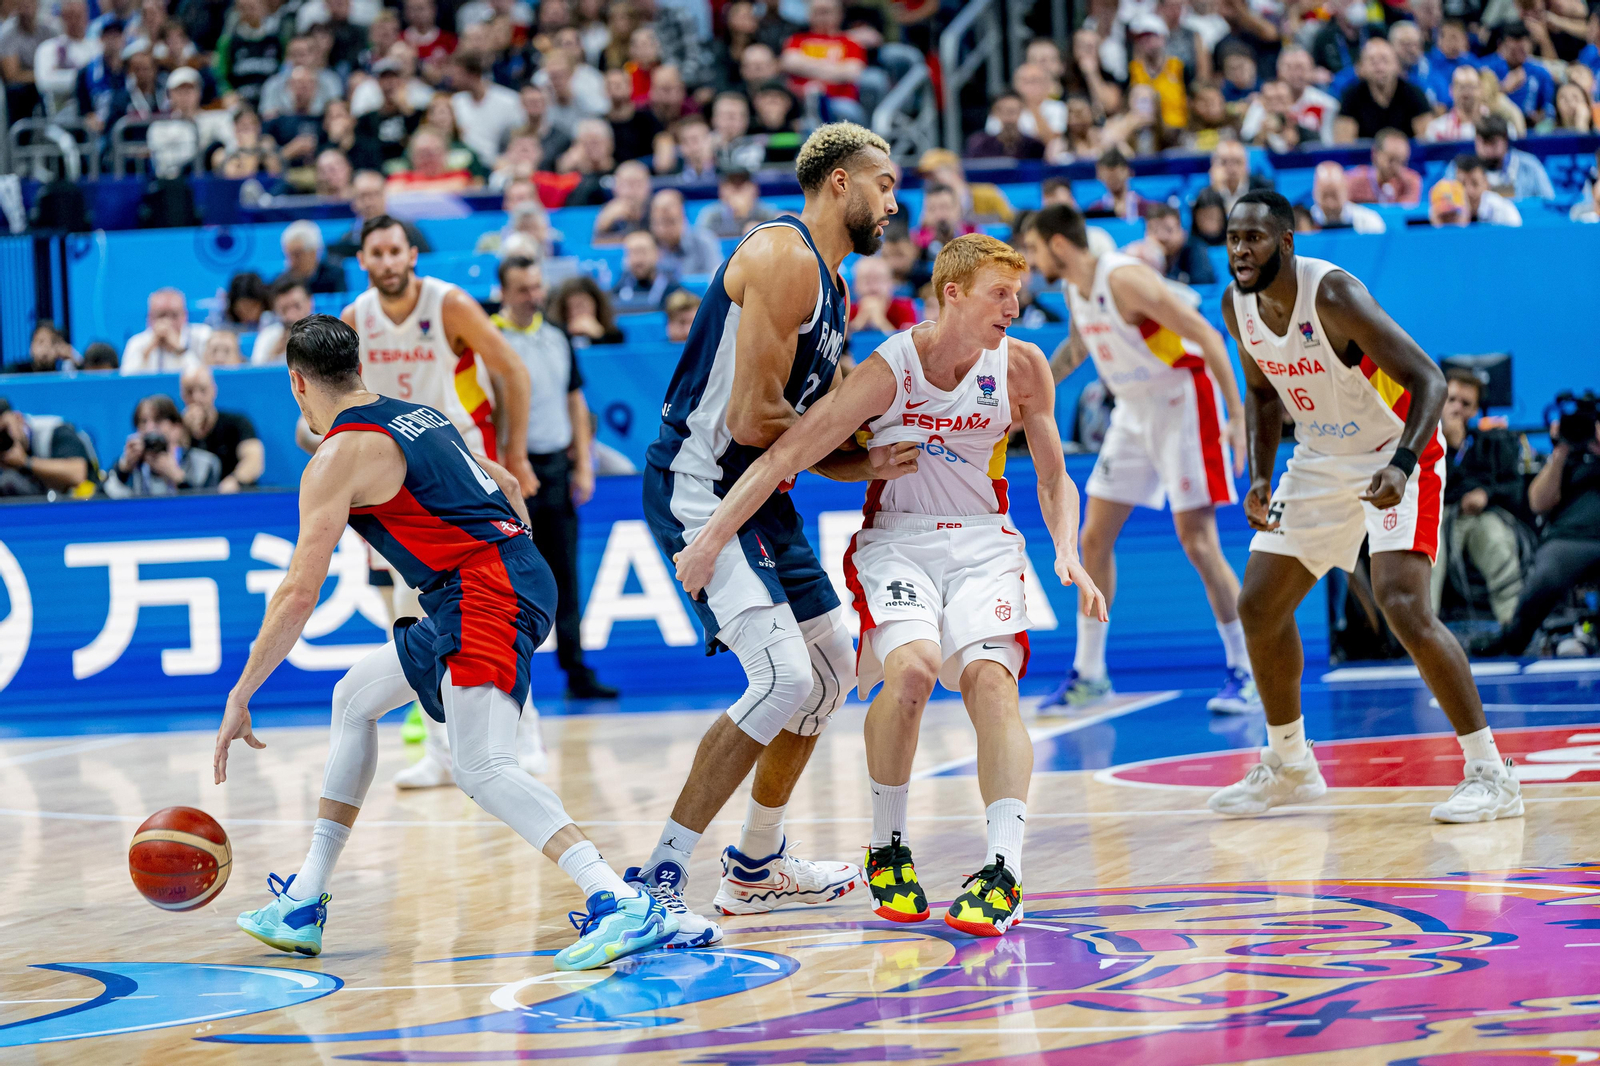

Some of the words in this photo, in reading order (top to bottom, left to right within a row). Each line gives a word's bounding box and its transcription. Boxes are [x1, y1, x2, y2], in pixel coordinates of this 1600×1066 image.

[1256, 356, 1326, 377] ESPAÑA
[397, 373, 413, 399] 5
[1287, 387, 1315, 412] 16
[902, 413, 991, 432] ESPAÑA
[451, 440, 500, 495] 4
[885, 600, 928, 611] network
